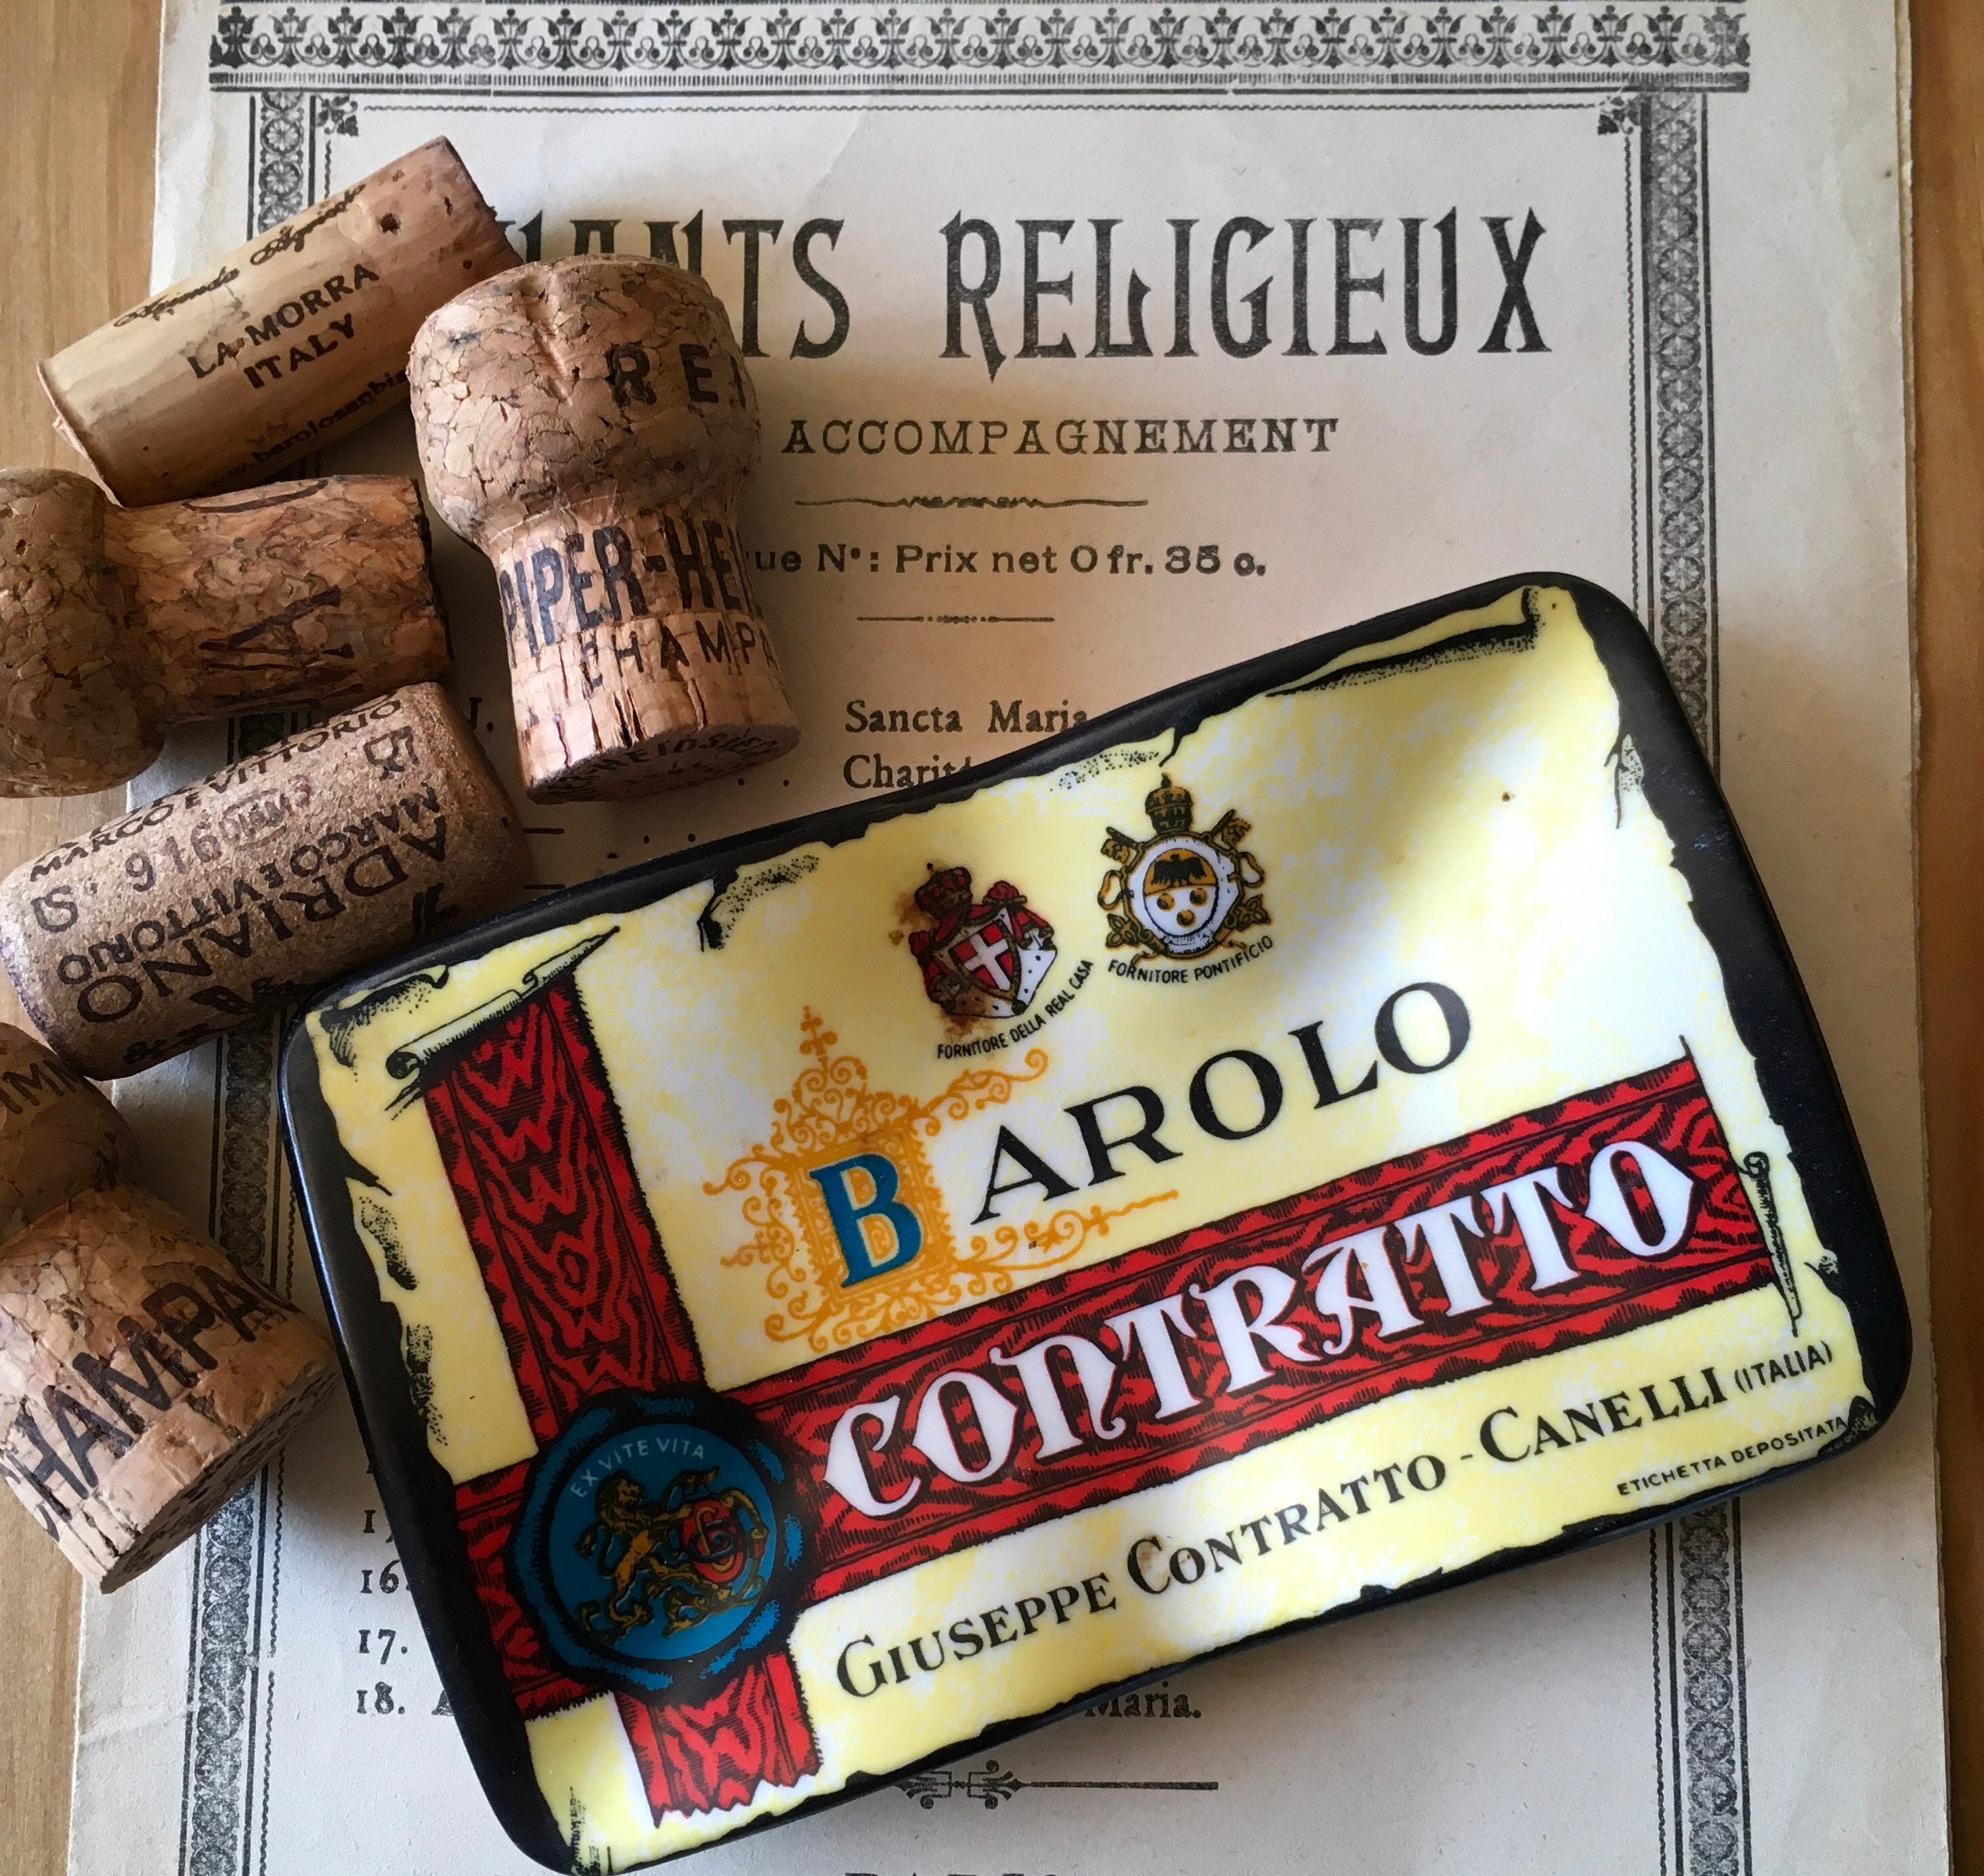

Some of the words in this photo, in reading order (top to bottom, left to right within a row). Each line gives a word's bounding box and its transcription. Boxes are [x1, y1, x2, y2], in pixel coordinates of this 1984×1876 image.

[186, 335, 244, 379] LA
[244, 263, 379, 345] MORRA
[938, 207, 1552, 382] RELIGIEUX
[243, 313, 355, 389] ITALY
[781, 417, 1339, 456] ACCOMPAGNEMENT
[896, 544, 978, 574] Prix
[991, 545, 1058, 574] net
[1106, 544, 1154, 575] fr.
[844, 699, 963, 733] Sancta
[29, 803, 175, 882] MARCO
[205, 699, 402, 795] VITTORIO
[291, 781, 443, 878] MARCO
[57, 879, 259, 987] VITTORIO
[77, 814, 447, 1023] ADRIANO
[1108, 958, 1189, 984] FORNITORE
[1194, 935, 1274, 980] PONTIFICIO
[936, 1031, 1009, 1060] FORNITORE
[1010, 1013, 1045, 1044] DELLA
[1044, 987, 1076, 1019] REAL
[1068, 958, 1094, 991] CASA
[822, 1140, 1696, 1518] CONTRATTO
[569, 1468, 600, 1499] EX
[597, 1438, 650, 1472] VITE
[656, 1437, 705, 1461] VITA
[1616, 1455, 1727, 1497] ETICHETTA
[1730, 1414, 1849, 1466] DEPOSITATA
[835, 1571, 1119, 1699] GIUSEPPE
[1125, 1454, 1448, 1596] CONTRATTO
[1478, 1365, 1728, 1464] CANELLI
[1733, 1340, 1835, 1395] (ITALIA)
[358, 1628, 408, 1665] 17.
[356, 1681, 406, 1715] 18.
